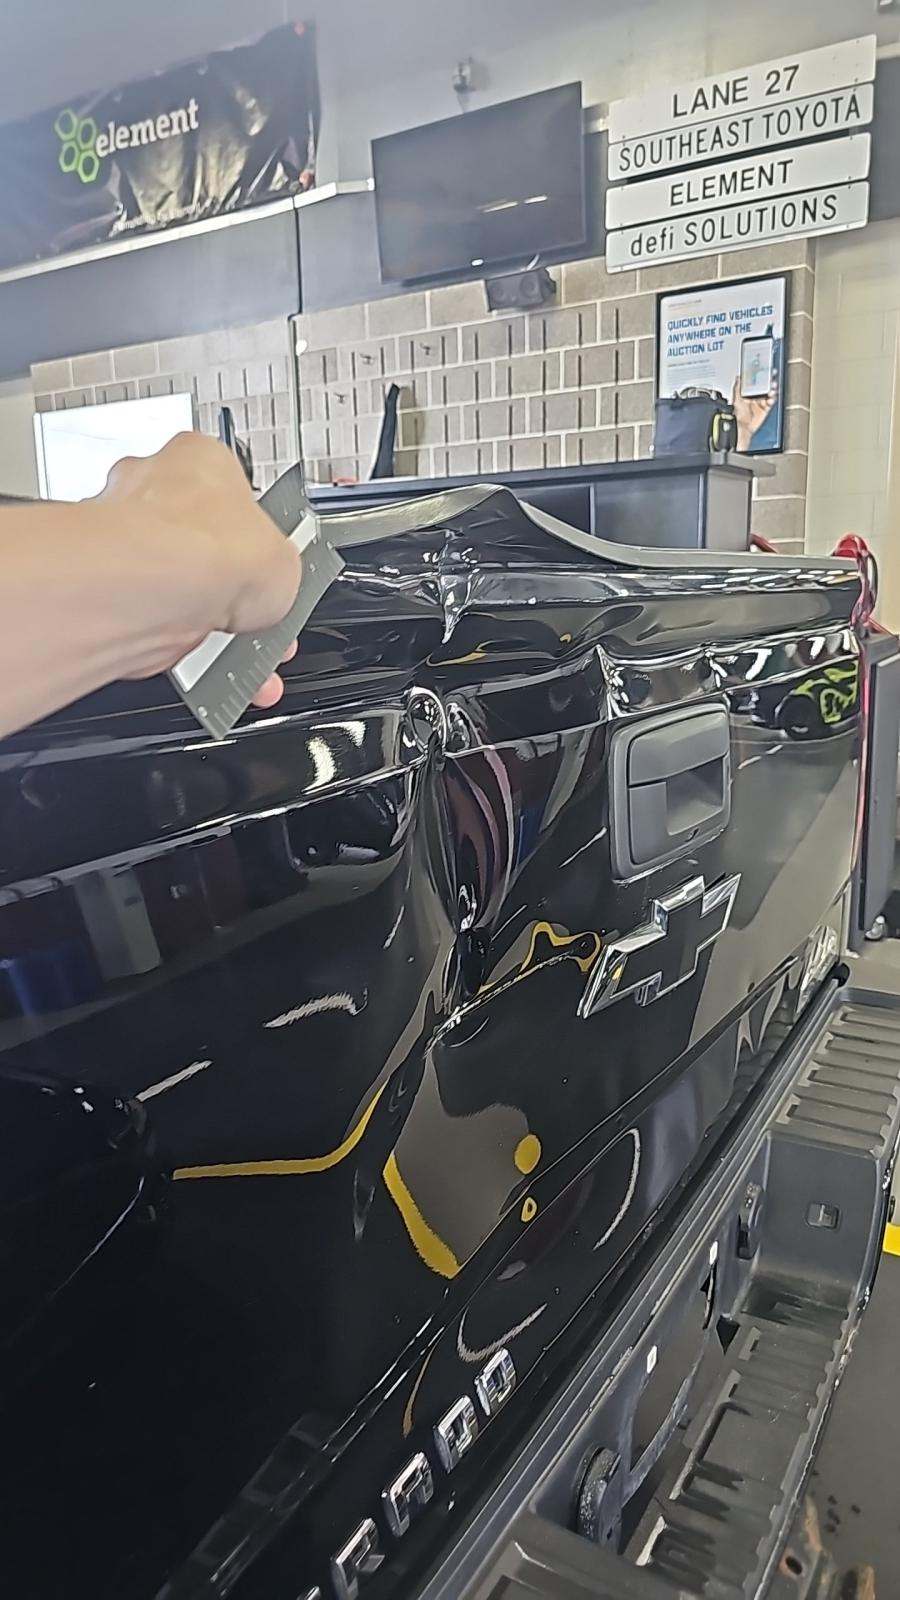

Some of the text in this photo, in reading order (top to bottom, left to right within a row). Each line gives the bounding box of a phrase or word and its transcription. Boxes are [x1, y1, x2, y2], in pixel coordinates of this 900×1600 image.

[672, 64, 800, 118] LANE 27
[95, 98, 199, 158] element
[618, 93, 861, 172] SOUTHEAST TOYOTA
[670, 159, 794, 207] ELEMENT
[630, 194, 838, 257] defi SOLUTIONS
[667, 305, 773, 332] QUICKLY FIND VEHICLES
[667, 323, 752, 344] ANYWHERE ON THE
[667, 340, 725, 358] AUCTION LOT
[298, 1347, 517, 1600] RADO
